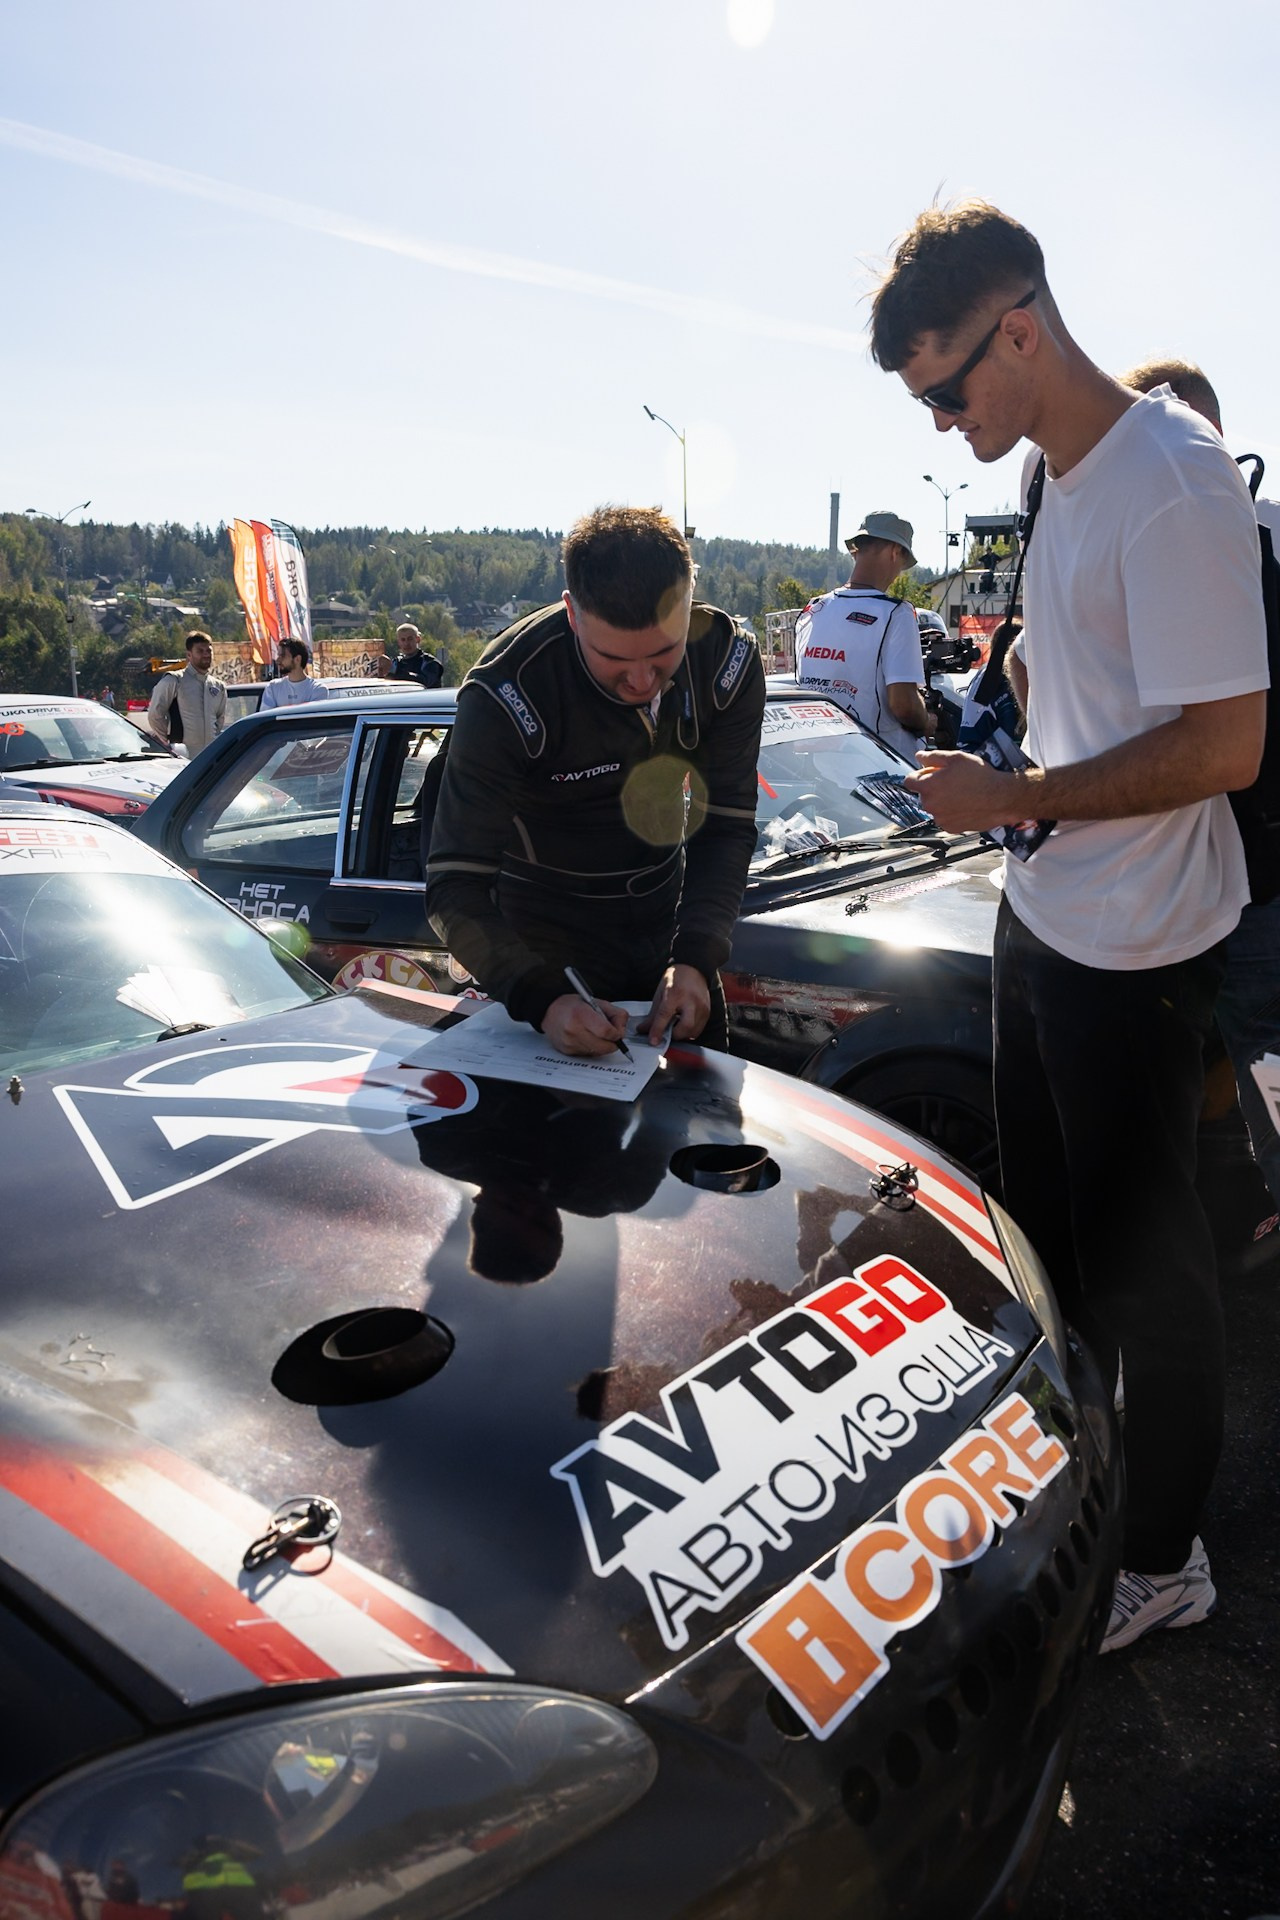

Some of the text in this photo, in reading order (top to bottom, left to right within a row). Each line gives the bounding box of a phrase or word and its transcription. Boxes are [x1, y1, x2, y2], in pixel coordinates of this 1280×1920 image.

[804, 646, 846, 662] MEDIA
[791, 705, 835, 719] FEST
[564, 763, 620, 782] AVTOGO
[239, 882, 286, 900] НЕТ
[560, 1259, 947, 1568] AVTOGO
[649, 1325, 1010, 1641] АВТО ИЗ США
